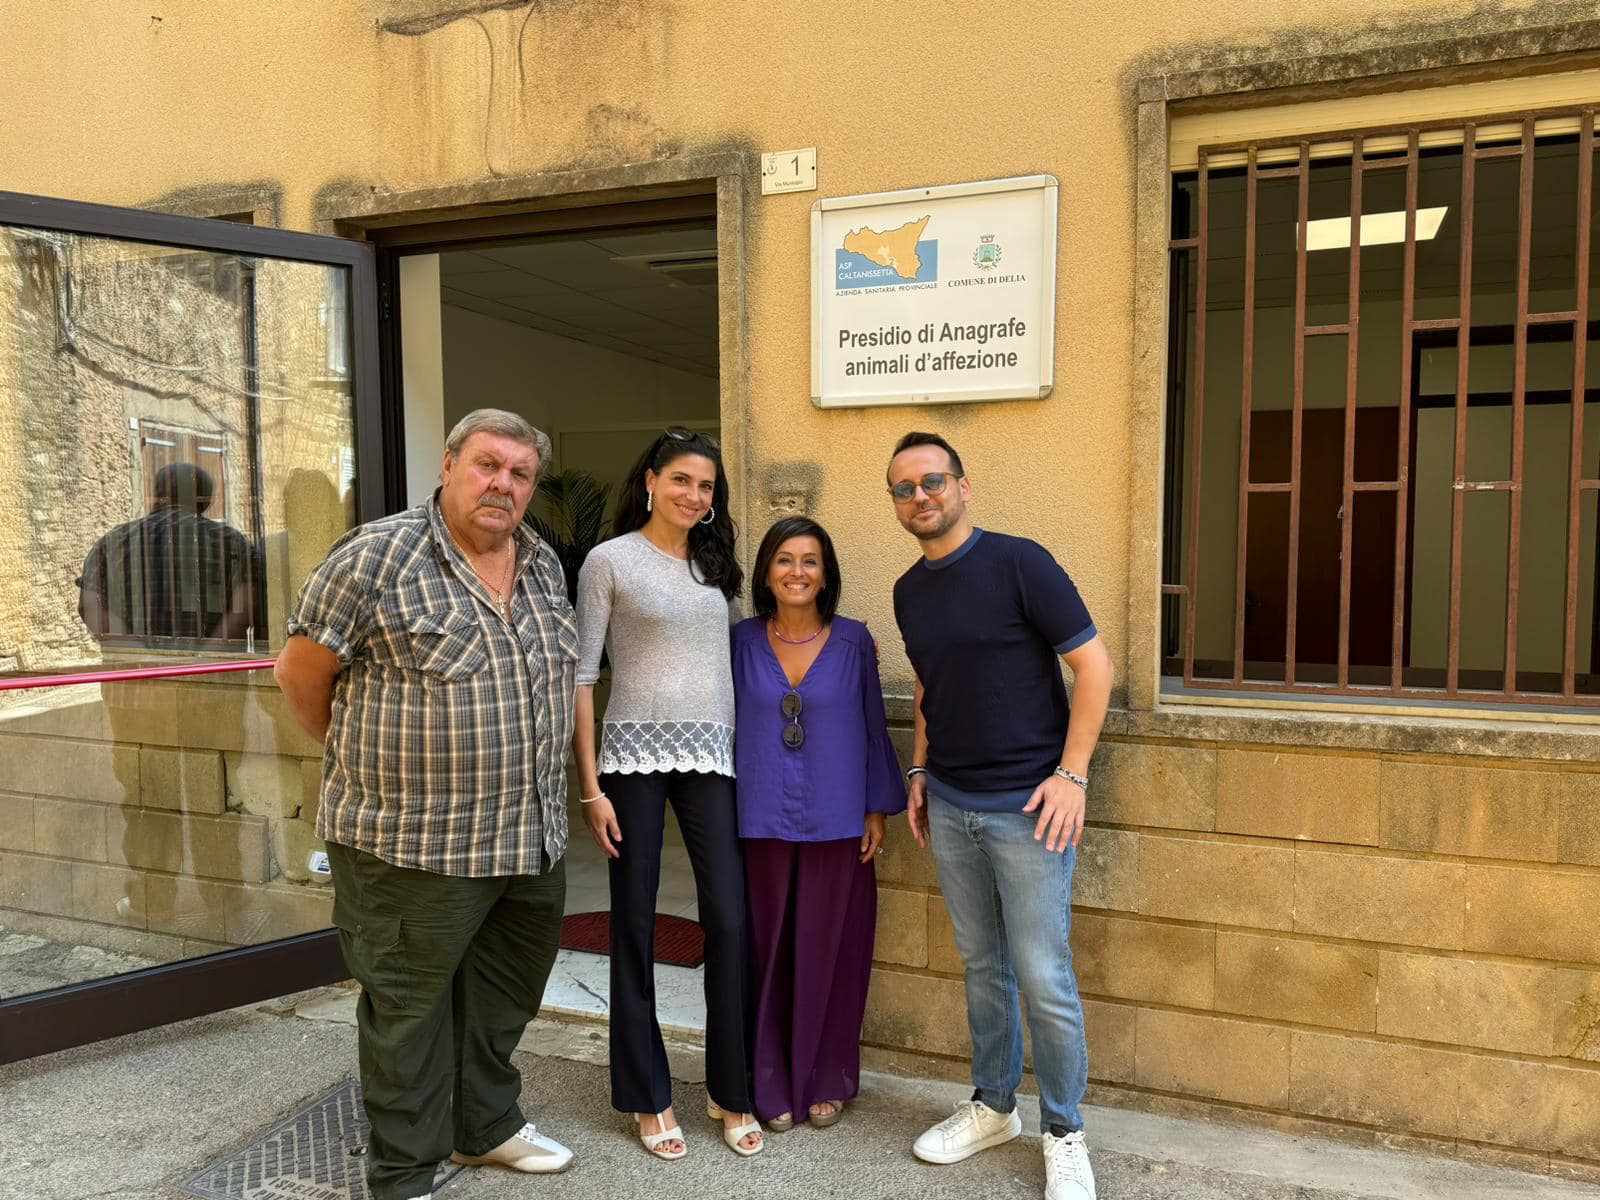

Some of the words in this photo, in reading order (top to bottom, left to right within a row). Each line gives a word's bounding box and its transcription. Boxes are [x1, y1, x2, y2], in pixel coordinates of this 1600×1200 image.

[791, 155, 799, 177] 1
[838, 261, 852, 271] ASP
[838, 268, 894, 280] CALTANISSETTA
[948, 277, 985, 288] COMUNE
[987, 276, 997, 284] DI
[999, 274, 1026, 283] DELIA
[864, 286, 896, 294] SANITARIA
[898, 282, 938, 291] PROVINCIALE
[839, 326, 912, 349] Presidio
[918, 323, 934, 343] di
[939, 317, 1026, 344] Anagrafe
[845, 354, 909, 376] animali
[915, 349, 1018, 373] d’affezione
